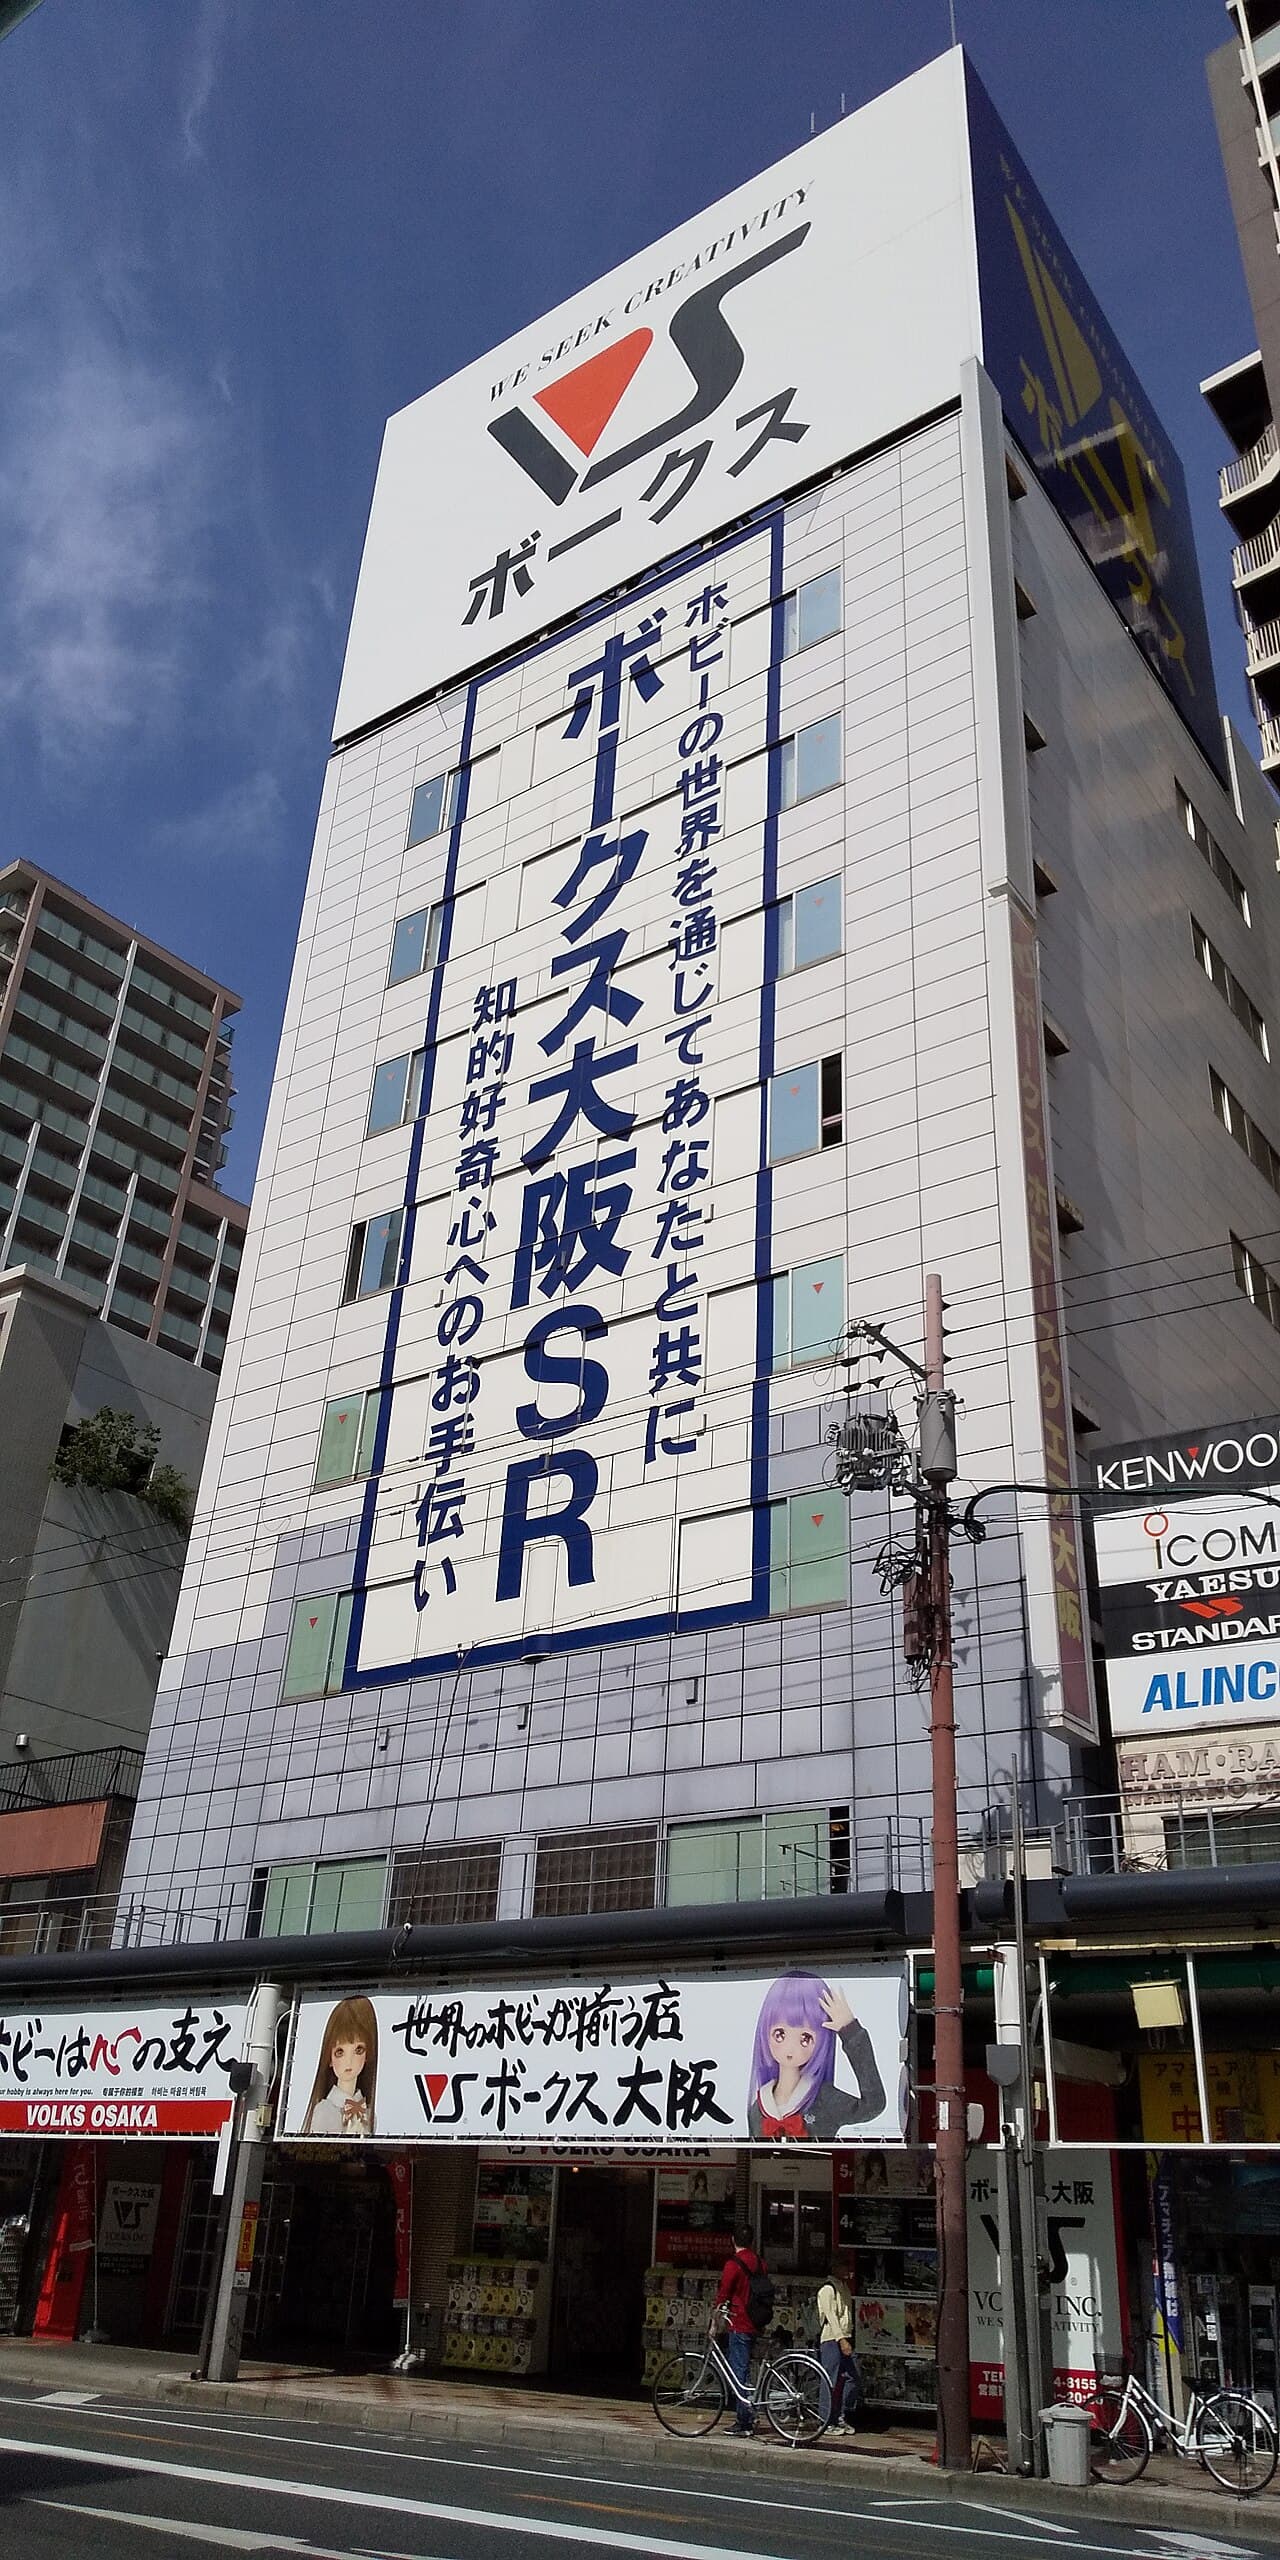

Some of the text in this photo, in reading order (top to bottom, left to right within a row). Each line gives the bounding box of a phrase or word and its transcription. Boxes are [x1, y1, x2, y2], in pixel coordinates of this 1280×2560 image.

[490, 180, 815, 402] WE SEEK CREATIVITY
[461, 387, 811, 626] ボークス
[645, 582, 729, 1464] ホビーの世界を通じてあなたと共に
[495, 607, 667, 1603] ボークス大阪SR
[414, 977, 518, 1611] 知的好奇心へのお手伝い
[1097, 1433, 1280, 1490] KENWOO
[1145, 1566, 1280, 1602] YAESU
[1142, 1660, 1280, 1713] ALINC
[392, 1979, 684, 2057] 世界のホビーが揃う店
[7, 2087, 24, 2097] hobby
[33, 2087, 54, 2097] always
[55, 2087, 69, 2095] here
[70, 2087, 79, 2095] for
[80, 2088, 94, 2097] you.
[27, 2104, 158, 2128] VOLKS OSAKA
[1055, 2295, 1102, 2318] INC.
